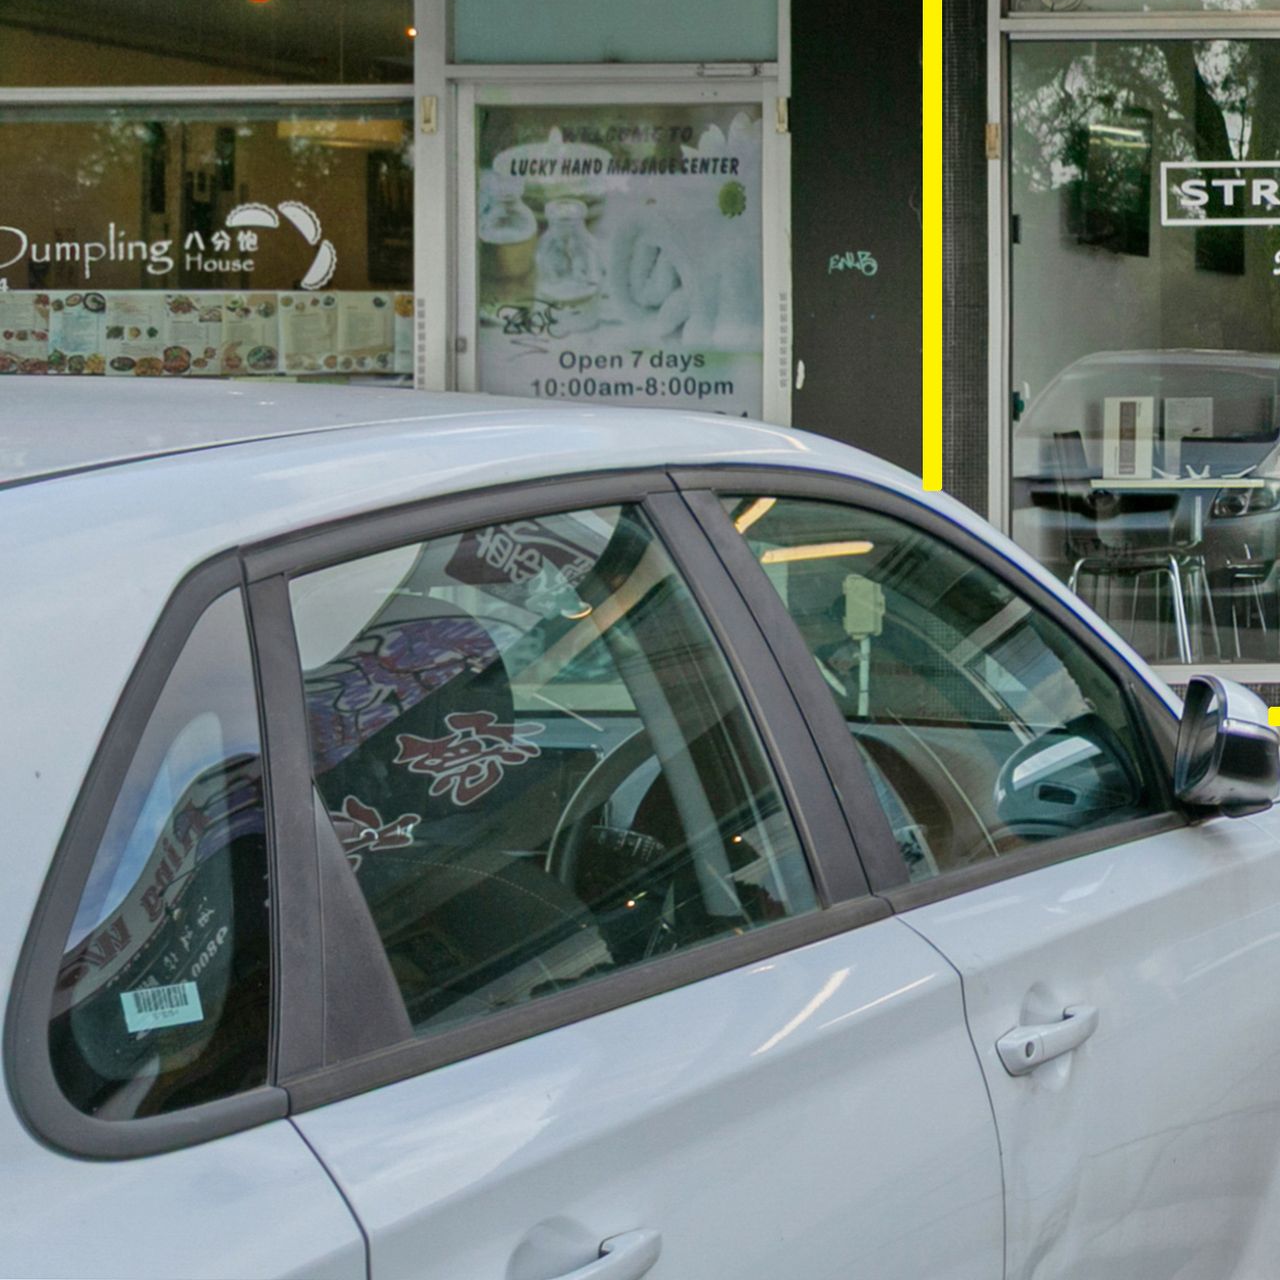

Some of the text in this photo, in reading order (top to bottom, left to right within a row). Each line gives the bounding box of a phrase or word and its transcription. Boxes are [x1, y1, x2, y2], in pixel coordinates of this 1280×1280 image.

[510, 156, 740, 177] LUCKY HAND MASSAGE CENTER
[184, 252, 256, 272] House
[558, 349, 706, 372] Open 7 days
[530, 377, 734, 400] 10:00am-8:00pm
